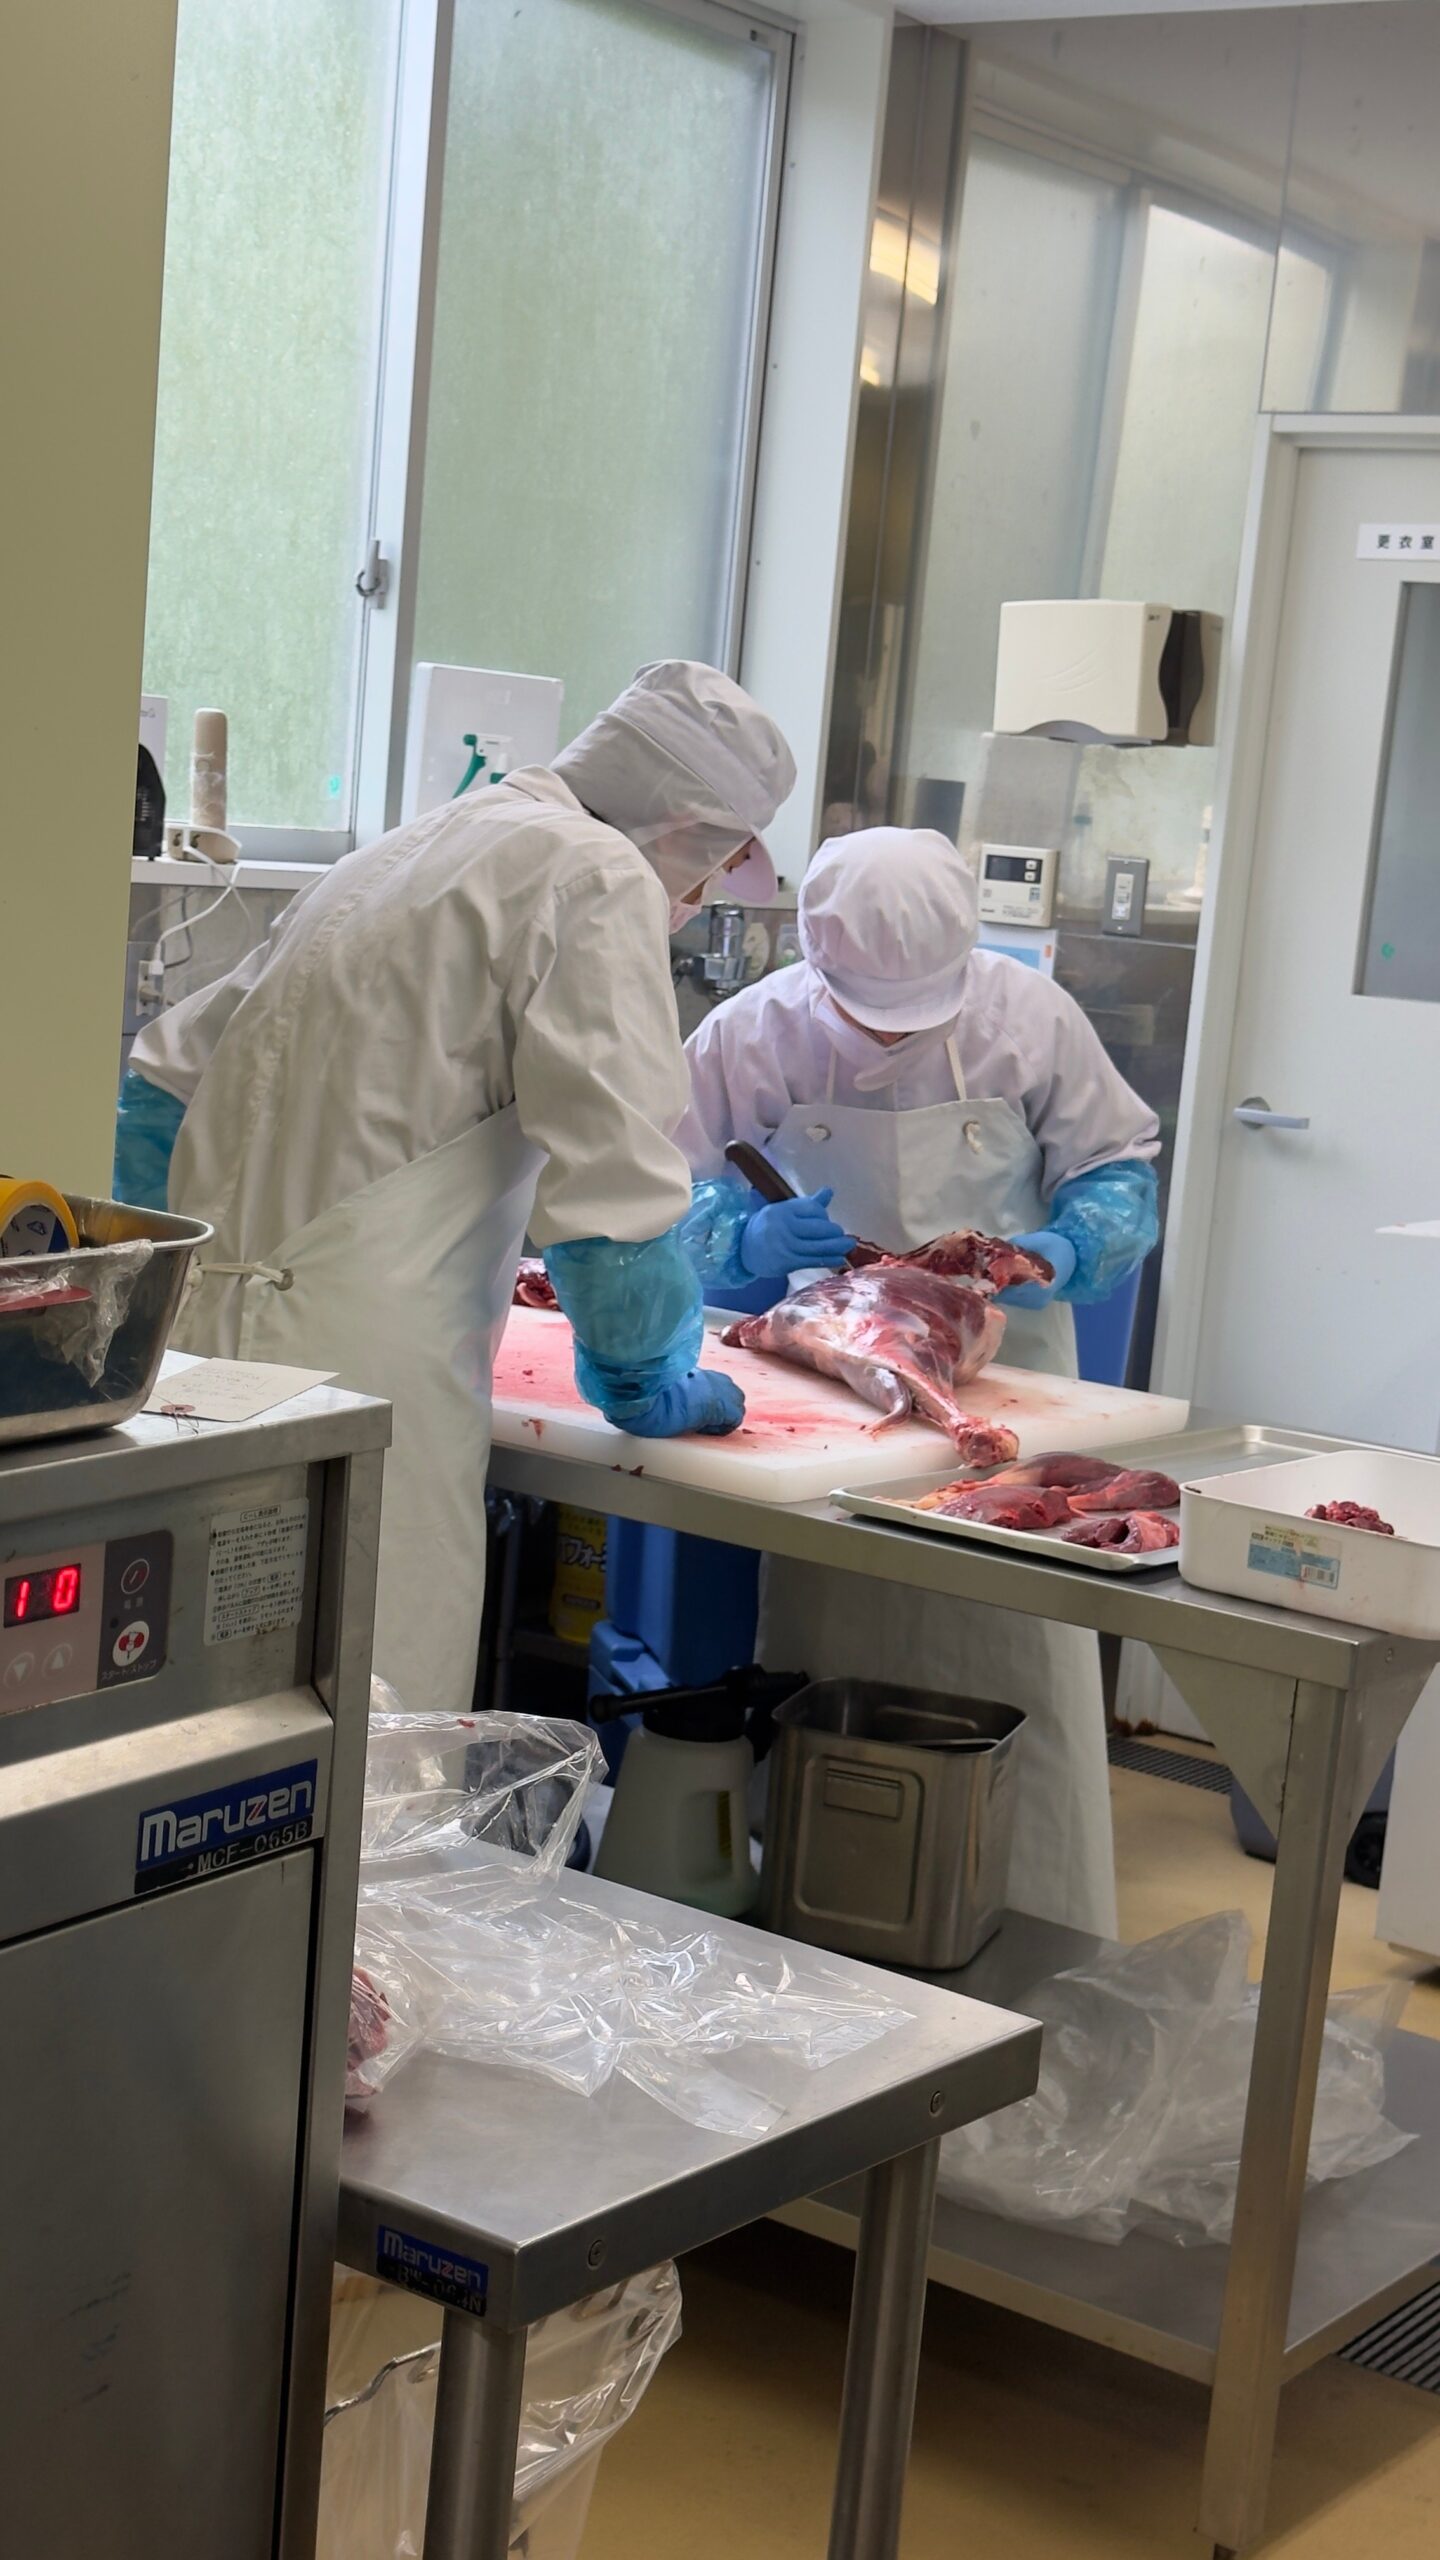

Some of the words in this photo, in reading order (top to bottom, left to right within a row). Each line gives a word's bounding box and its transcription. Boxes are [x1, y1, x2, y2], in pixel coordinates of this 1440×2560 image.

[1377, 534, 1434, 549] 更衣室
[140, 1780, 313, 1862] Maruzen
[383, 2230, 481, 2289] Maruzen
